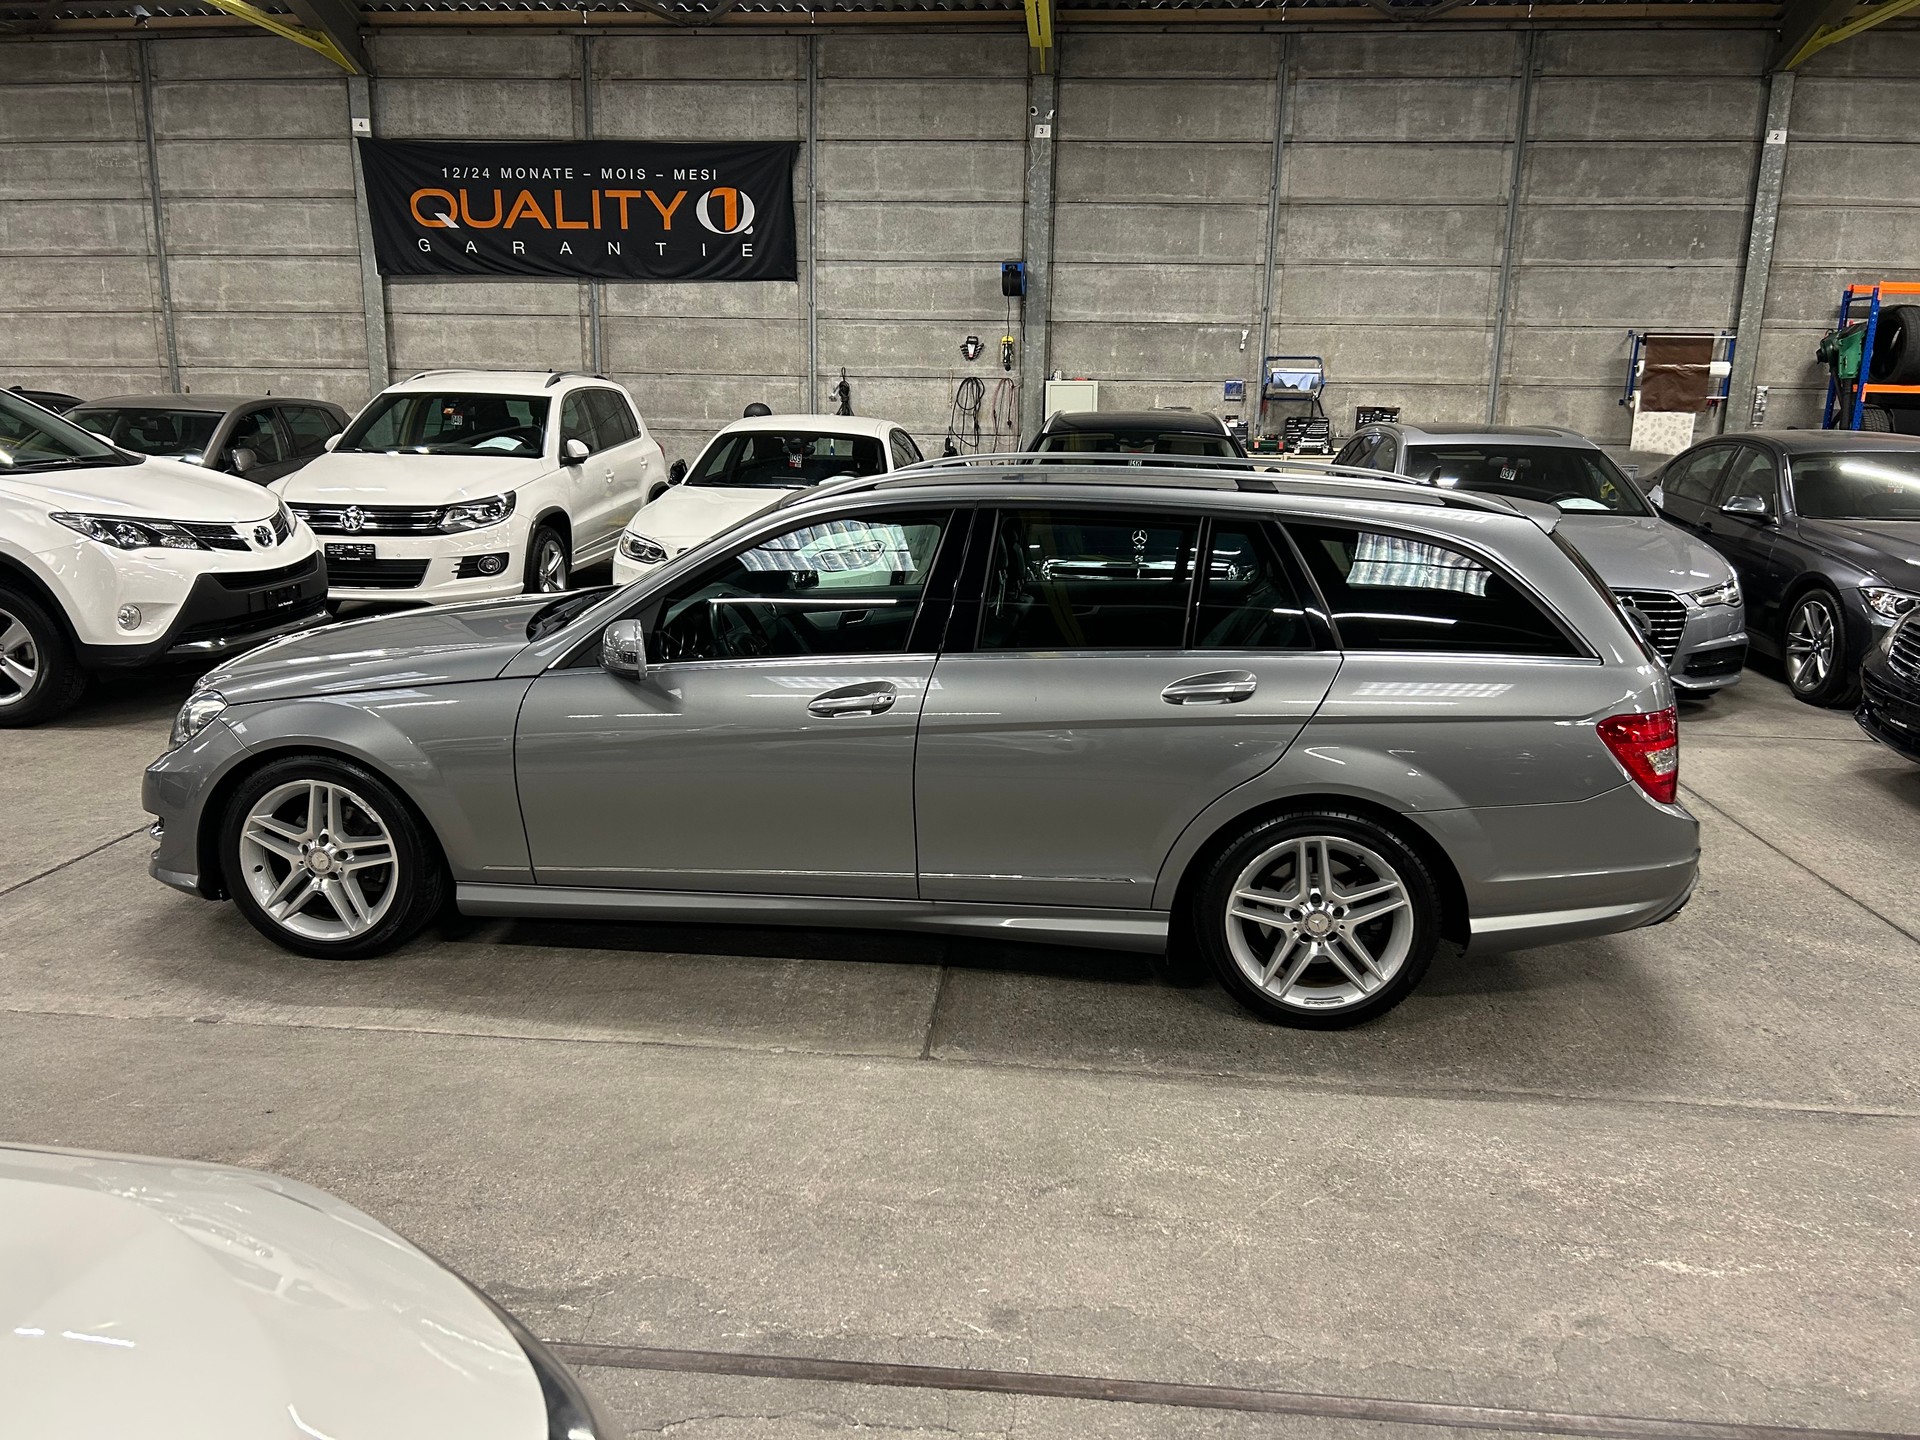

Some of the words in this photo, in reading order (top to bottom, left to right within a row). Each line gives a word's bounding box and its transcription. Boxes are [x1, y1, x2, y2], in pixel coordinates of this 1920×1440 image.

[1039, 127, 1044, 135] 3
[441, 167, 491, 179] 12/24
[500, 167, 574, 180] MONATE
[601, 168, 646, 180] MOIS
[673, 168, 718, 181] MESI
[410, 188, 688, 231] QUALITY
[417, 238, 754, 257] GARANTIE
